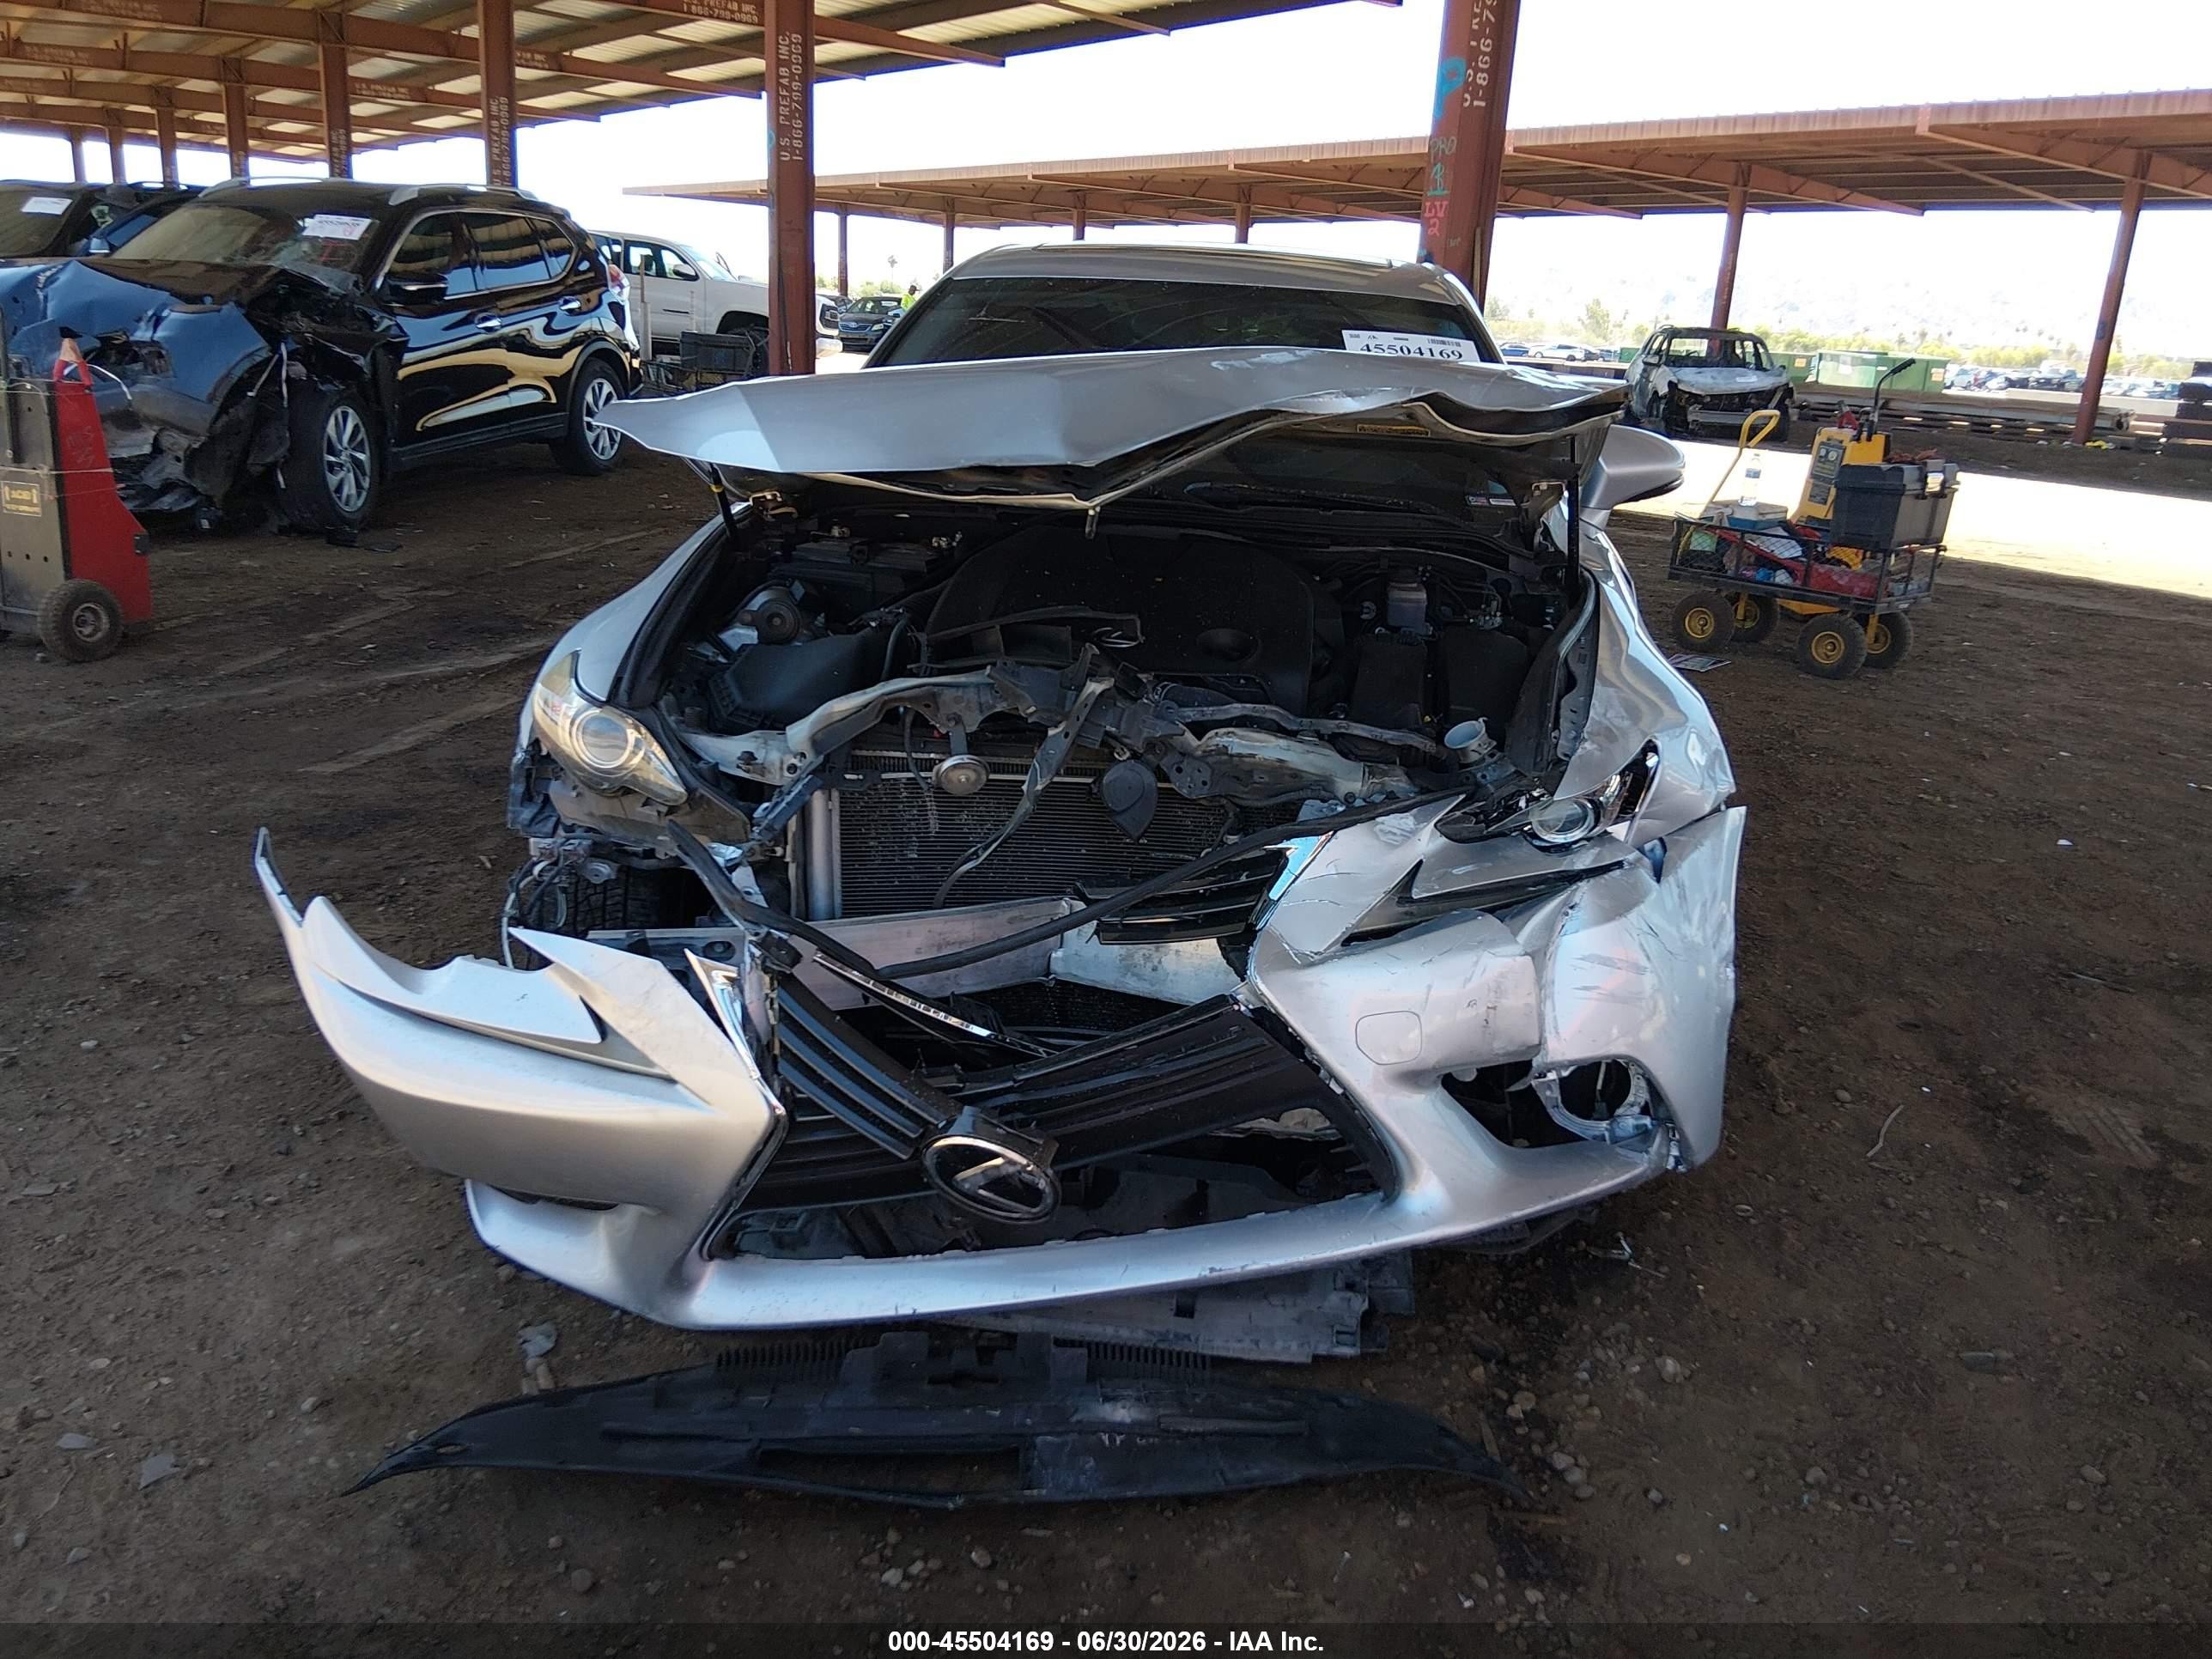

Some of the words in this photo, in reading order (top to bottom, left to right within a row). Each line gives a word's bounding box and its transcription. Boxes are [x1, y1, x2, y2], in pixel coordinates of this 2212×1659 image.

[779, 67, 790, 125] PREFAB
[792, 33, 804, 161] 1-866-799-0969
[489, 120, 501, 161] PREFAB
[780, 132, 791, 161] U.S.
[1428, 218, 1440, 237] 2
[1360, 343, 1463, 360] 45504169
